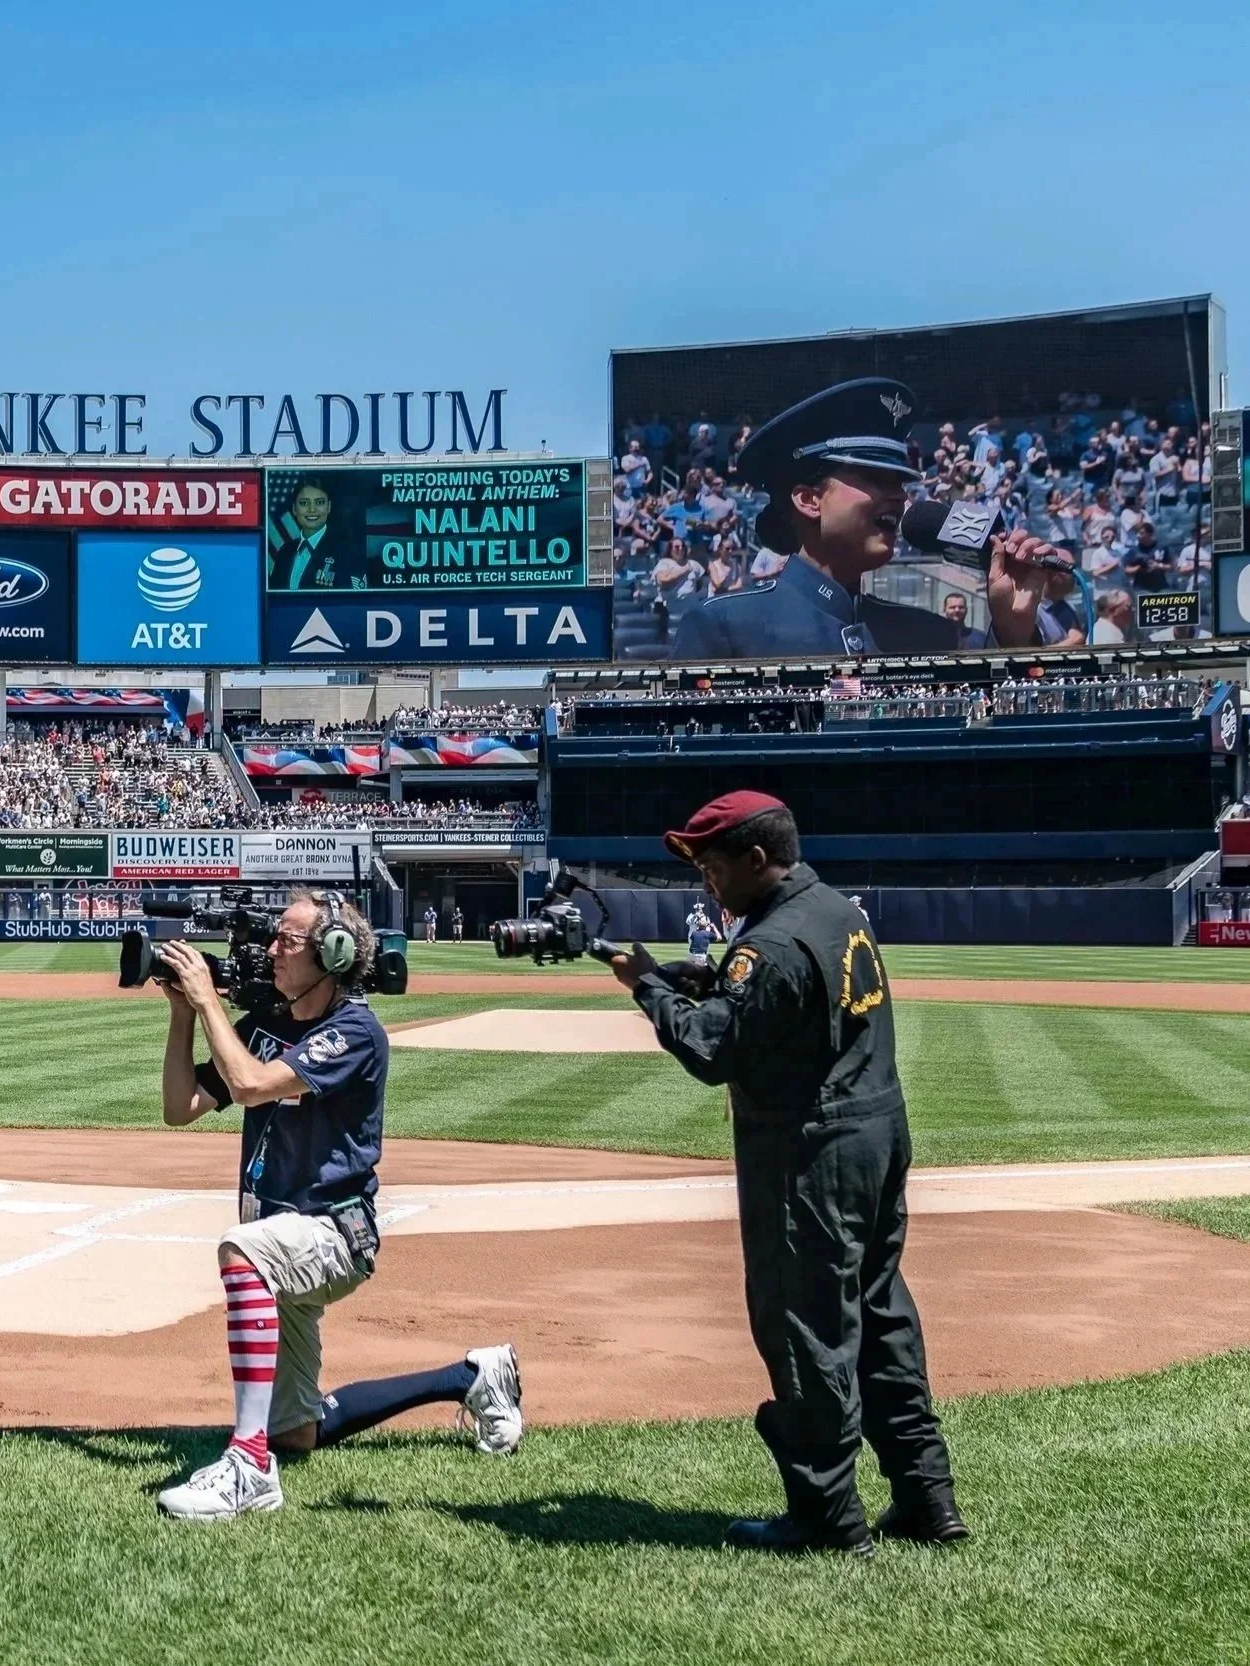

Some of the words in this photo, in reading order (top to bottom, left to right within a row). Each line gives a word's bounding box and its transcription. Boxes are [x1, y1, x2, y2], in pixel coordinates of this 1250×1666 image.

[189, 389, 508, 457] STADIUM
[382, 471, 493, 487] PERFORMING
[499, 468, 570, 484] TODAY'S
[0, 480, 243, 516] GATORADE
[392, 487, 476, 502] NATIONAL
[482, 485, 560, 500] ANTHEM:
[415, 505, 535, 534] NALANI
[382, 538, 570, 569] QUINTELLO
[383, 574, 406, 584] U.S.
[410, 573, 430, 584] AIR
[434, 573, 472, 583] FORCE
[475, 571, 506, 582] TECH
[510, 570, 573, 582] SERGEANT
[1142, 596, 1196, 607] ARMITRON
[1146, 607, 1189, 624] 12:58
[366, 606, 587, 648] DELTA
[131, 623, 208, 650] AT&T
[1045, 666, 1081, 674] mastercard
[712, 679, 745, 687] mastercard
[330, 791, 381, 802] TERRACE
[33, 837, 54, 845] Circle
[59, 838, 103, 846] Morningside
[275, 837, 337, 851] DANNON
[374, 833, 439, 842] STEINERSPORTS.COM
[444, 833, 499, 842] YANKEES-STEINER
[500, 833, 545, 842] COLLECTIBLES
[116, 836, 235, 858] BUDWEISER
[245, 854, 278, 864] ANOTHER
[281, 854, 304, 864] GREAT
[306, 854, 330, 864] BRONX
[5, 864, 24, 873] What
[25, 864, 51, 873] Matters
[292, 868, 303, 876] EST
[5, 919, 72, 938] StubHub
